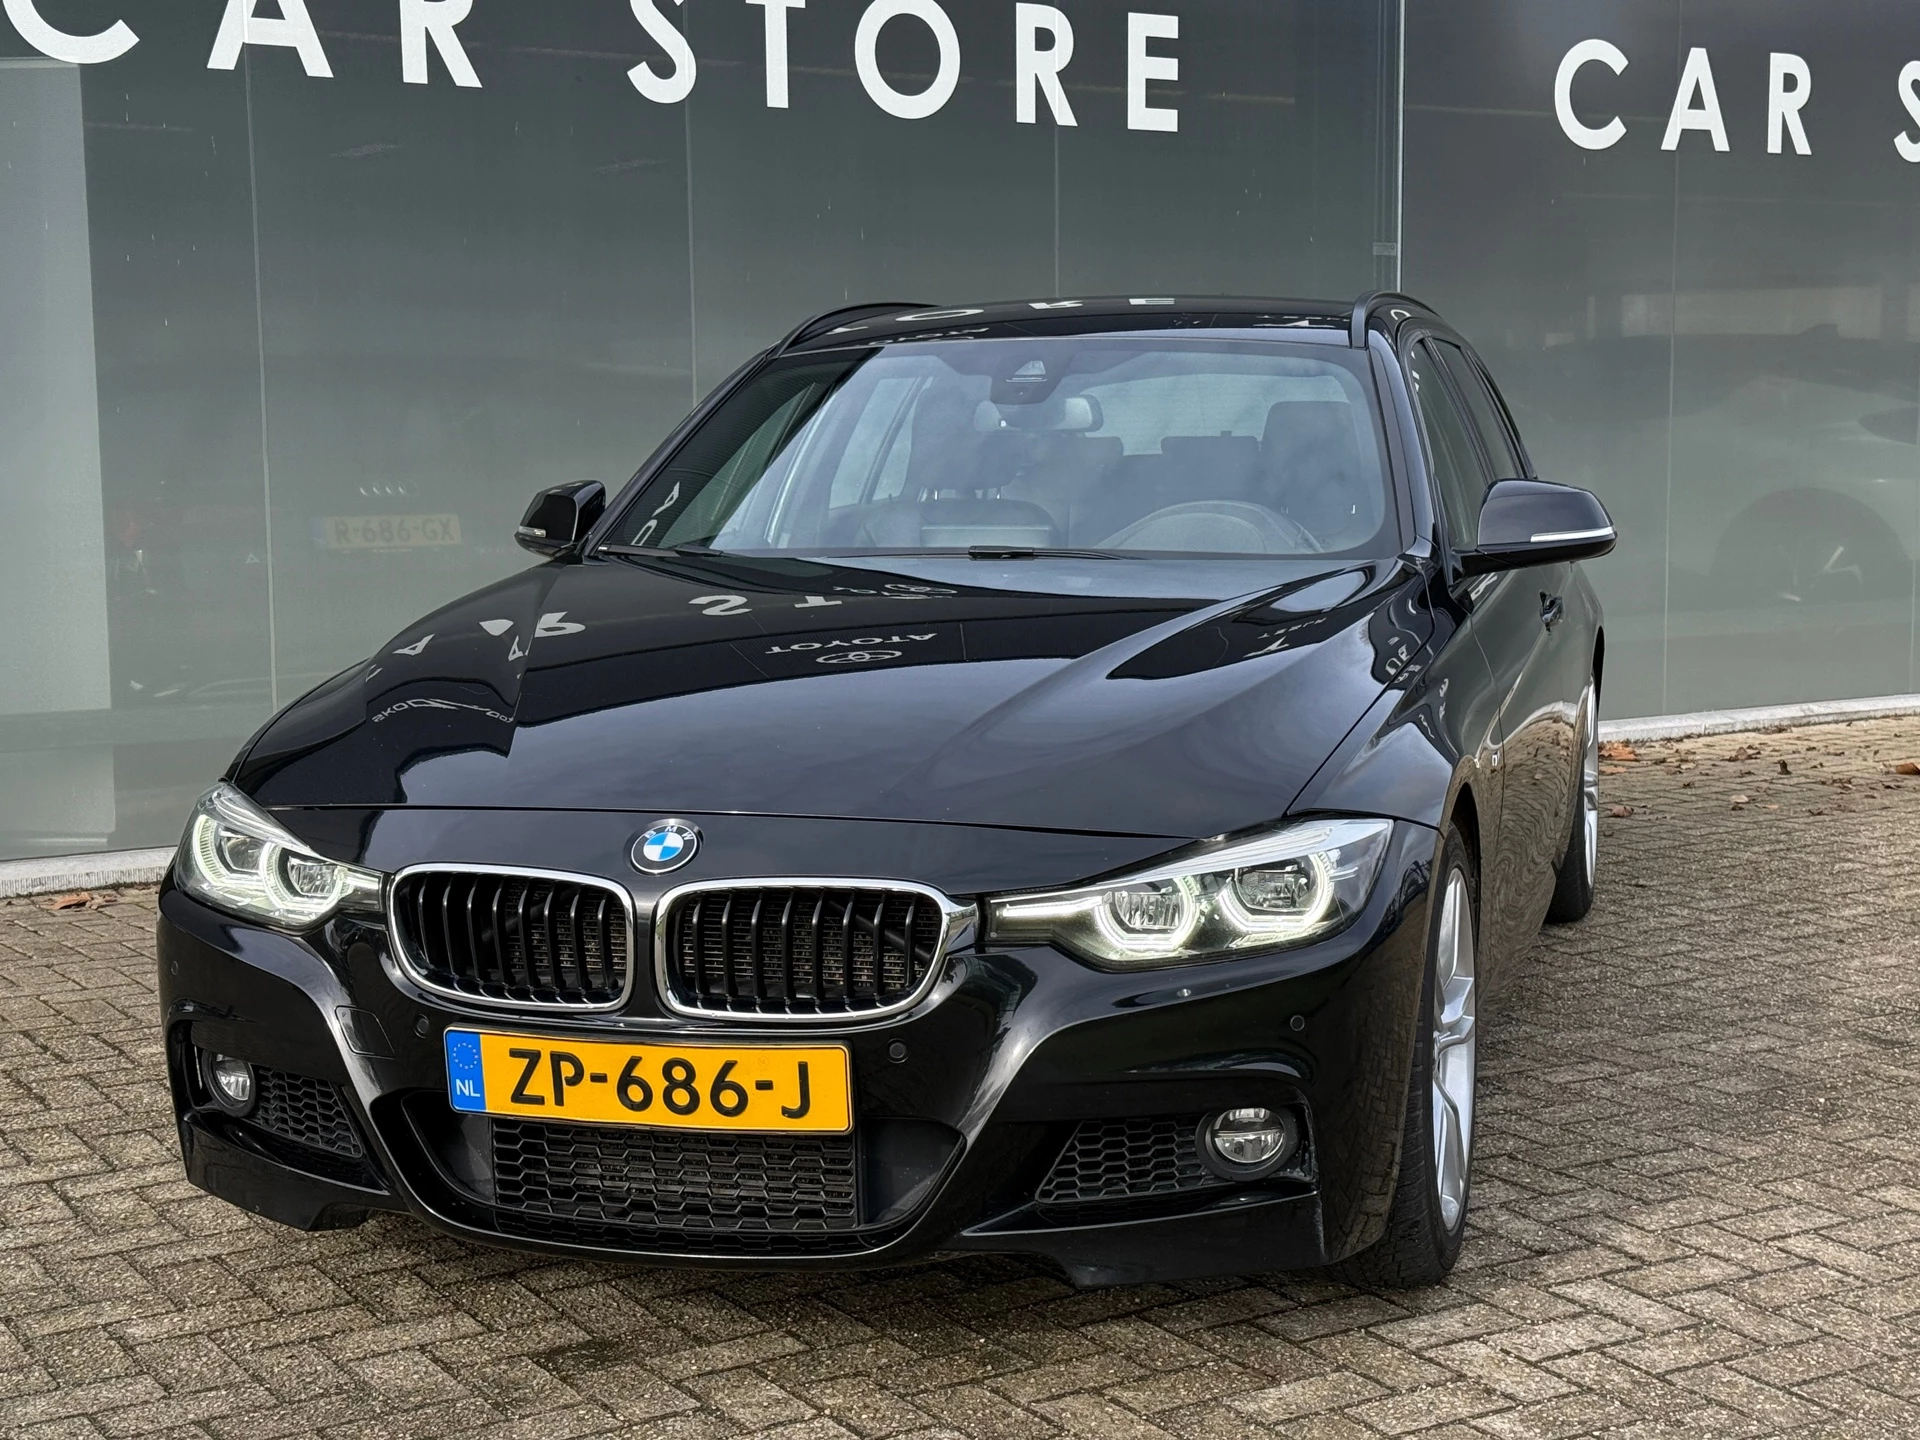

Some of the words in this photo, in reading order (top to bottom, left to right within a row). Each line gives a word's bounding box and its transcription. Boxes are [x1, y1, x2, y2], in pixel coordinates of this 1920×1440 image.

[627, 0, 1179, 132] STORE
[1554, 39, 1813, 156] CAR
[334, 517, 455, 544] R-686-GX
[643, 825, 694, 841] BMW
[456, 1078, 481, 1098] NL
[508, 1047, 811, 1120] ZP-686-J
